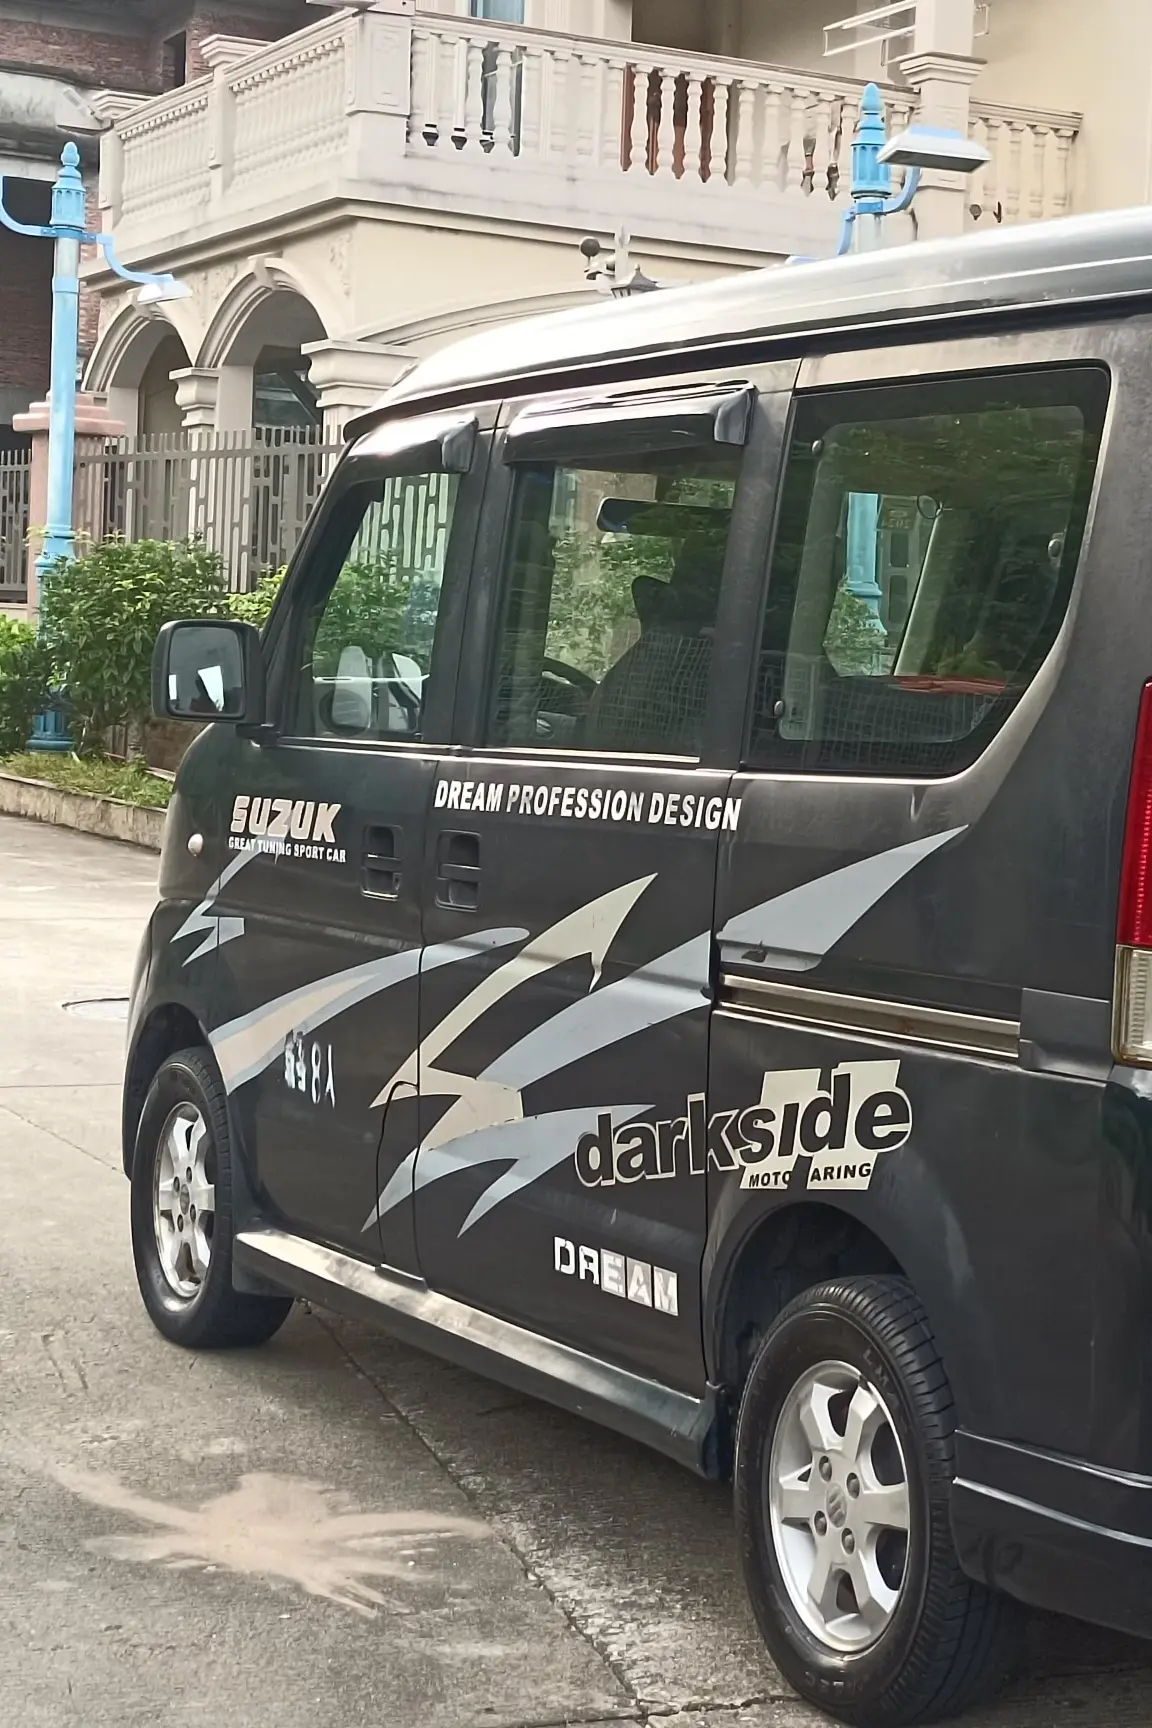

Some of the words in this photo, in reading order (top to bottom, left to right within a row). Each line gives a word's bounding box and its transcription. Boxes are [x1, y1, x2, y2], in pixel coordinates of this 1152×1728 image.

[230, 795, 341, 843] SUZUK
[433, 779, 504, 812] DREAM
[506, 783, 645, 822] PROFESSION
[647, 791, 742, 831] DESIGN
[228, 836, 256, 851] GREAT
[257, 839, 292, 856] TUNING
[293, 843, 325, 860] SPORT
[326, 848, 346, 863] CAR
[575, 1072, 913, 1188] darkside
[810, 1162, 872, 1183] ARING
[554, 1236, 678, 1316] DREAM
